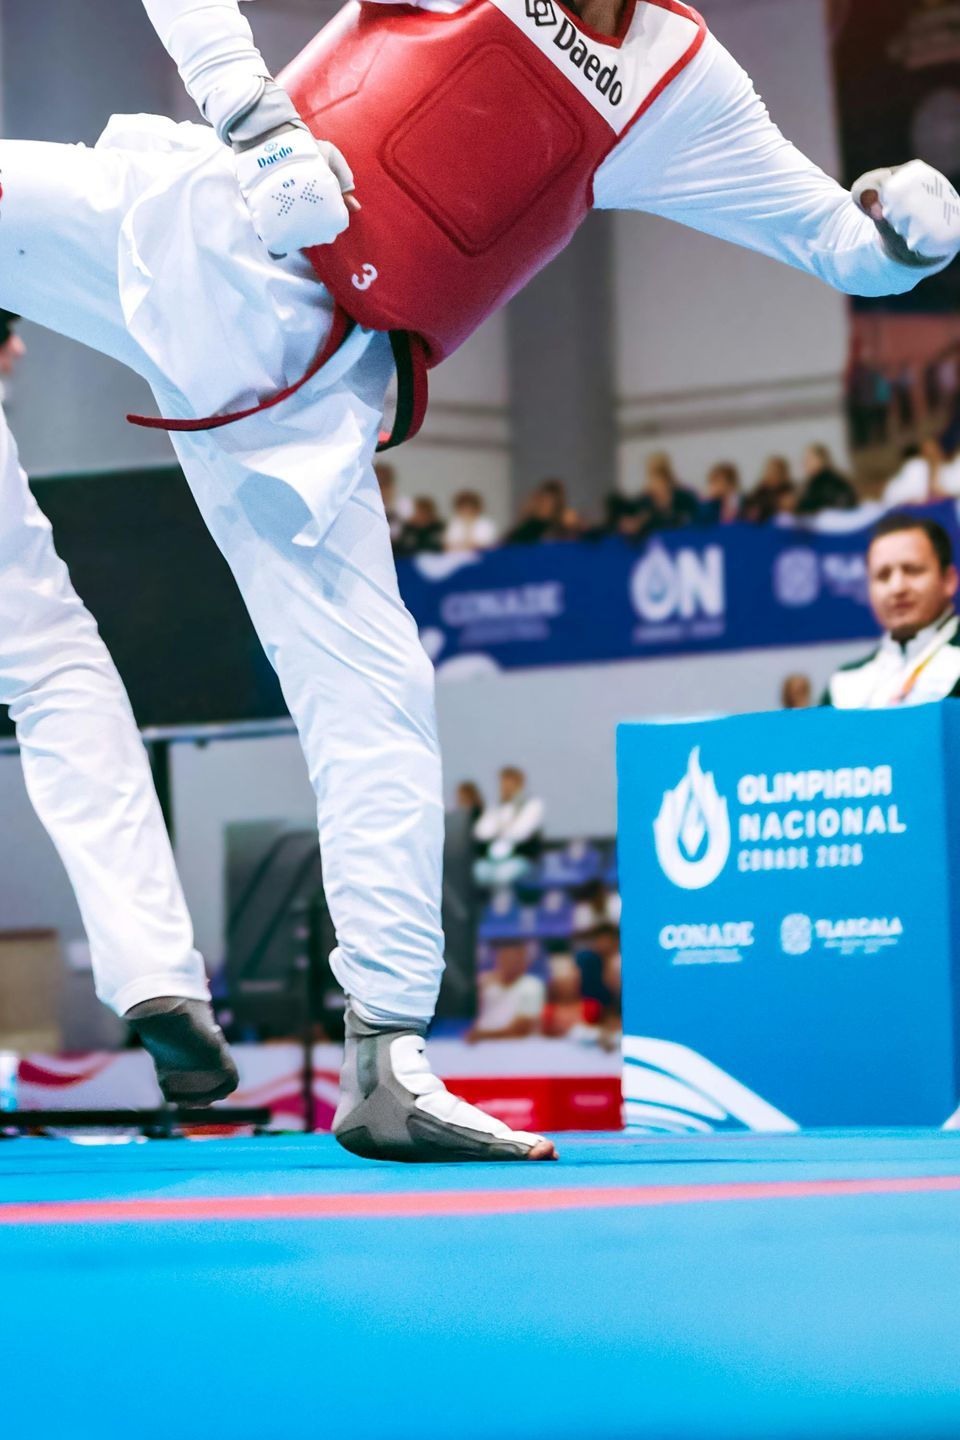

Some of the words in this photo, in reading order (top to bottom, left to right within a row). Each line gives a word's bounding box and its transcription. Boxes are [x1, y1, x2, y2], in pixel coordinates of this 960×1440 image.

[552, 16, 623, 107] Daedo
[257, 146, 293, 168] Daedo
[351, 262, 379, 291] 3
[737, 765, 893, 805] OLIMPIADA
[739, 804, 907, 842] NACIONAL
[659, 921, 754, 949] CONADE
